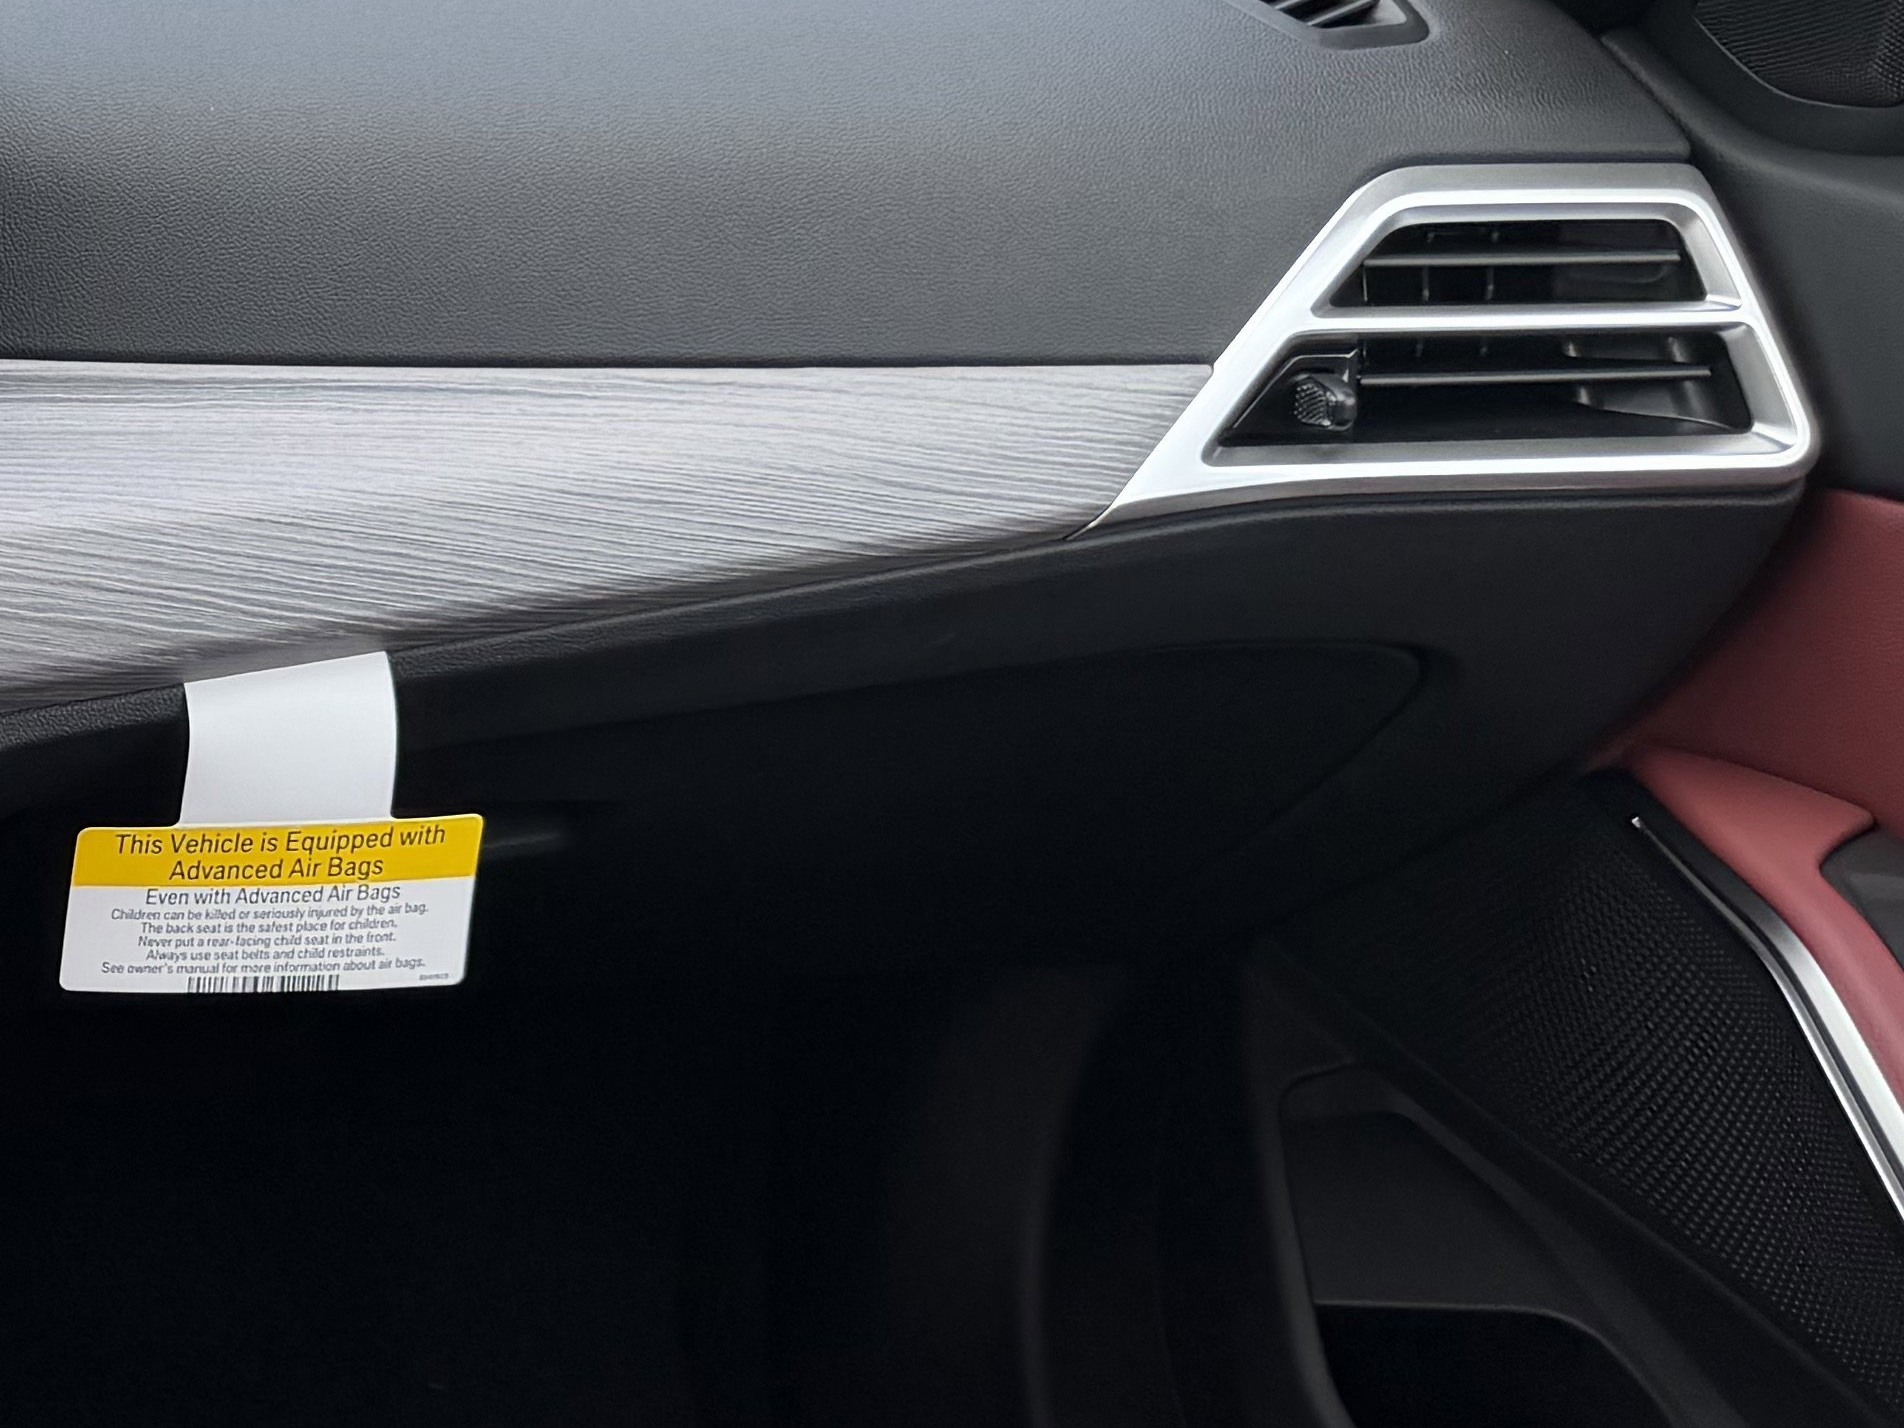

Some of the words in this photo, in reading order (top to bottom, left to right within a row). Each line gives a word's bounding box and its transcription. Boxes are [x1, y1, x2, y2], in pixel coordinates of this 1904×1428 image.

[115, 833, 163, 854] This
[170, 832, 254, 854] Vehicle
[260, 832, 278, 852] is
[286, 827, 394, 854] Equipped
[400, 824, 446, 846] with
[168, 858, 284, 880] Advanced
[288, 857, 322, 878] Air
[328, 856, 385, 880] Bags
[145, 888, 189, 905] Even
[193, 887, 230, 904] with
[235, 885, 324, 904] Advanced
[327, 884, 353, 902] Air
[357, 884, 401, 903] Bags
[111, 908, 160, 921] Children
[163, 910, 185, 920] can
[187, 909, 203, 920] be
[238, 910, 251, 920] or
[253, 906, 305, 920] seriously
[307, 904, 348, 921] injured
[350, 905, 363, 919] by
[366, 904, 386, 916] the
[387, 903, 401, 914] air
[141, 922, 163, 933] The
[166, 921, 194, 934] back
[196, 922, 221, 934] seat
[224, 922, 234, 933] is
[236, 922, 255, 933] the
[257, 920, 293, 933] safest
[295, 920, 328, 934] place
[330, 919, 345, 931] for
[138, 935, 172, 947] Never
[175, 936, 195, 950] put
[197, 938, 205, 947] a
[206, 934, 270, 950] rear-facing
[273, 933, 302, 946] child
[304, 933, 330, 945] seat
[331, 932, 343, 944] in
[345, 932, 364, 944] the
[145, 949, 188, 963] Always
[190, 951, 212, 961] use
[214, 949, 239, 960] seat
[241, 948, 270, 960] belts
[272, 947, 295, 959] and
[297, 946, 326, 959] child
[101, 961, 124, 974] See
[176, 961, 220, 974] manual
[222, 961, 238, 973] for
[240, 962, 270, 973] more
[273, 958, 340, 973] information
[343, 957, 376, 971] about
[378, 957, 392, 969] air
